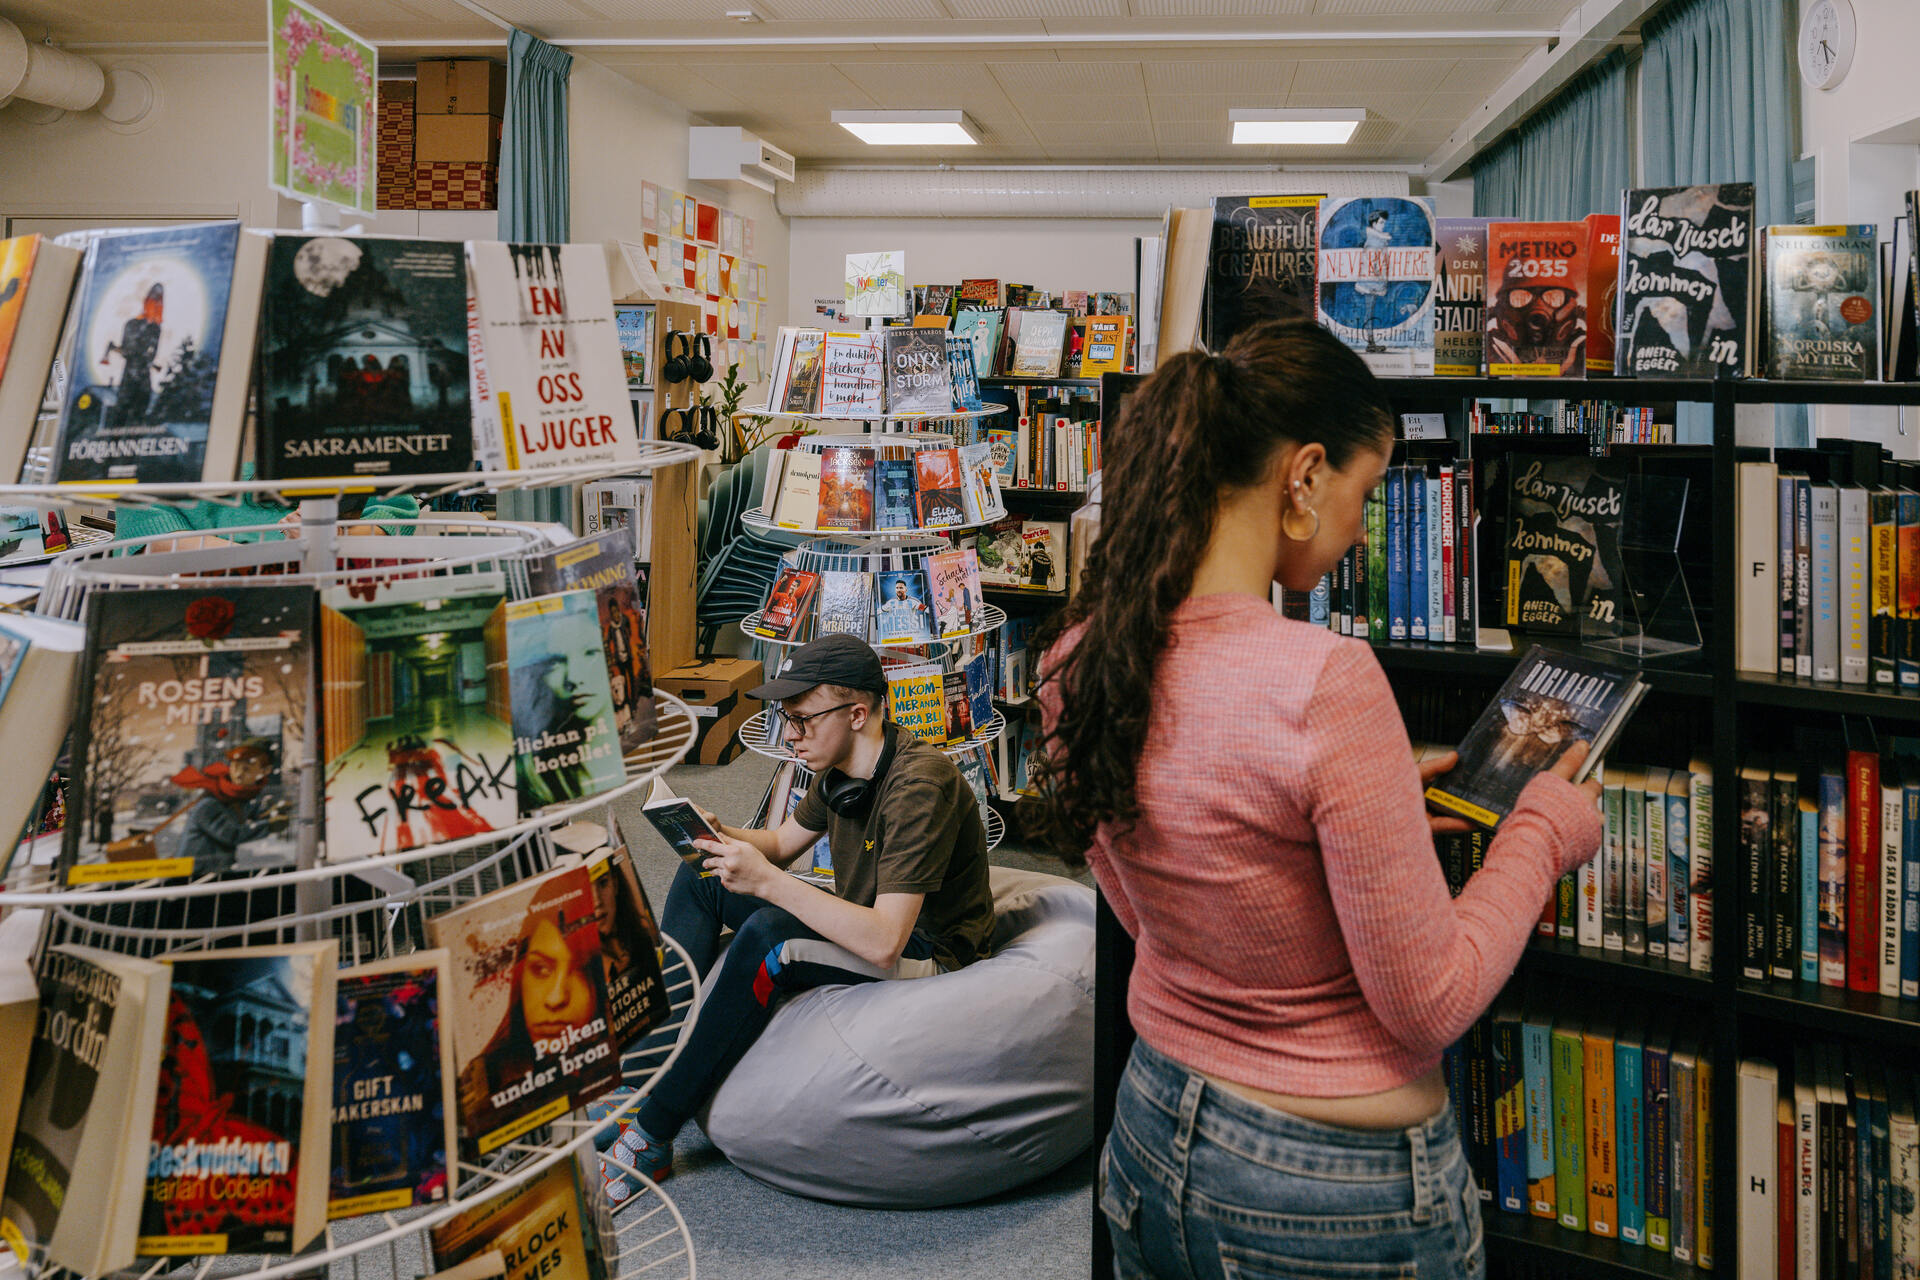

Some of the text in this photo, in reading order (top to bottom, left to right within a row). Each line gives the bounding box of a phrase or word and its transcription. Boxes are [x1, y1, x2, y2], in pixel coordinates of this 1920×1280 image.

[1628, 195, 1746, 257] där ljuset
[1499, 241, 1577, 258] METRO
[1810, 239, 1872, 250] GAIMAN
[1325, 250, 1430, 280] NEVERWHERE
[1453, 260, 1478, 270] DEN
[1508, 259, 1568, 278] 2035
[1625, 259, 1713, 301] kommer
[530, 286, 563, 316] EN
[541, 329, 565, 360] AV
[1088, 333, 1119, 343] FRST
[1782, 338, 1864, 355] NORDISKA
[896, 352, 941, 369] ONYX
[1636, 347, 1678, 361] ANETTE
[1709, 336, 1738, 365] in
[1796, 352, 1857, 368] MYTER
[1636, 358, 1679, 371] EGGERT
[537, 372, 583, 404] OSS
[896, 373, 945, 389] STORM
[1408, 416, 1421, 424] Ett
[1409, 425, 1424, 433] ord
[520, 415, 617, 454] LJUGER
[284, 434, 452, 459] SAKRAMENTET
[1514, 461, 1621, 519] där ljuset
[932, 506, 956, 516] ELLEN
[1442, 477, 1453, 547] KORRIDORER
[1511, 518, 1592, 562] kommer
[1753, 562, 1765, 578] F
[1588, 594, 1614, 623] in
[201, 655, 210, 678] I
[138, 677, 264, 704] ROSENS
[892, 682, 941, 699] VI KOM-
[166, 700, 236, 726] MITT
[895, 700, 919, 713] MER
[896, 711, 942, 726] BARA BLI
[586, 722, 609, 744] på
[534, 742, 614, 776] hotellet
[1885, 843, 1896, 864] JAG
[1885, 866, 1896, 885] SKA
[1885, 926, 1896, 939] ER
[1885, 942, 1896, 966] ALLA
[533, 1017, 607, 1061] Pojken
[491, 1041, 611, 1109] under bron
[353, 1075, 394, 1101] GIFT
[147, 1135, 290, 1179] Beskyddaren
[1801, 1113, 1812, 1197] LIN HALLBERG
[211, 1173, 274, 1201] Coben
[1751, 1176, 1766, 1194] H
